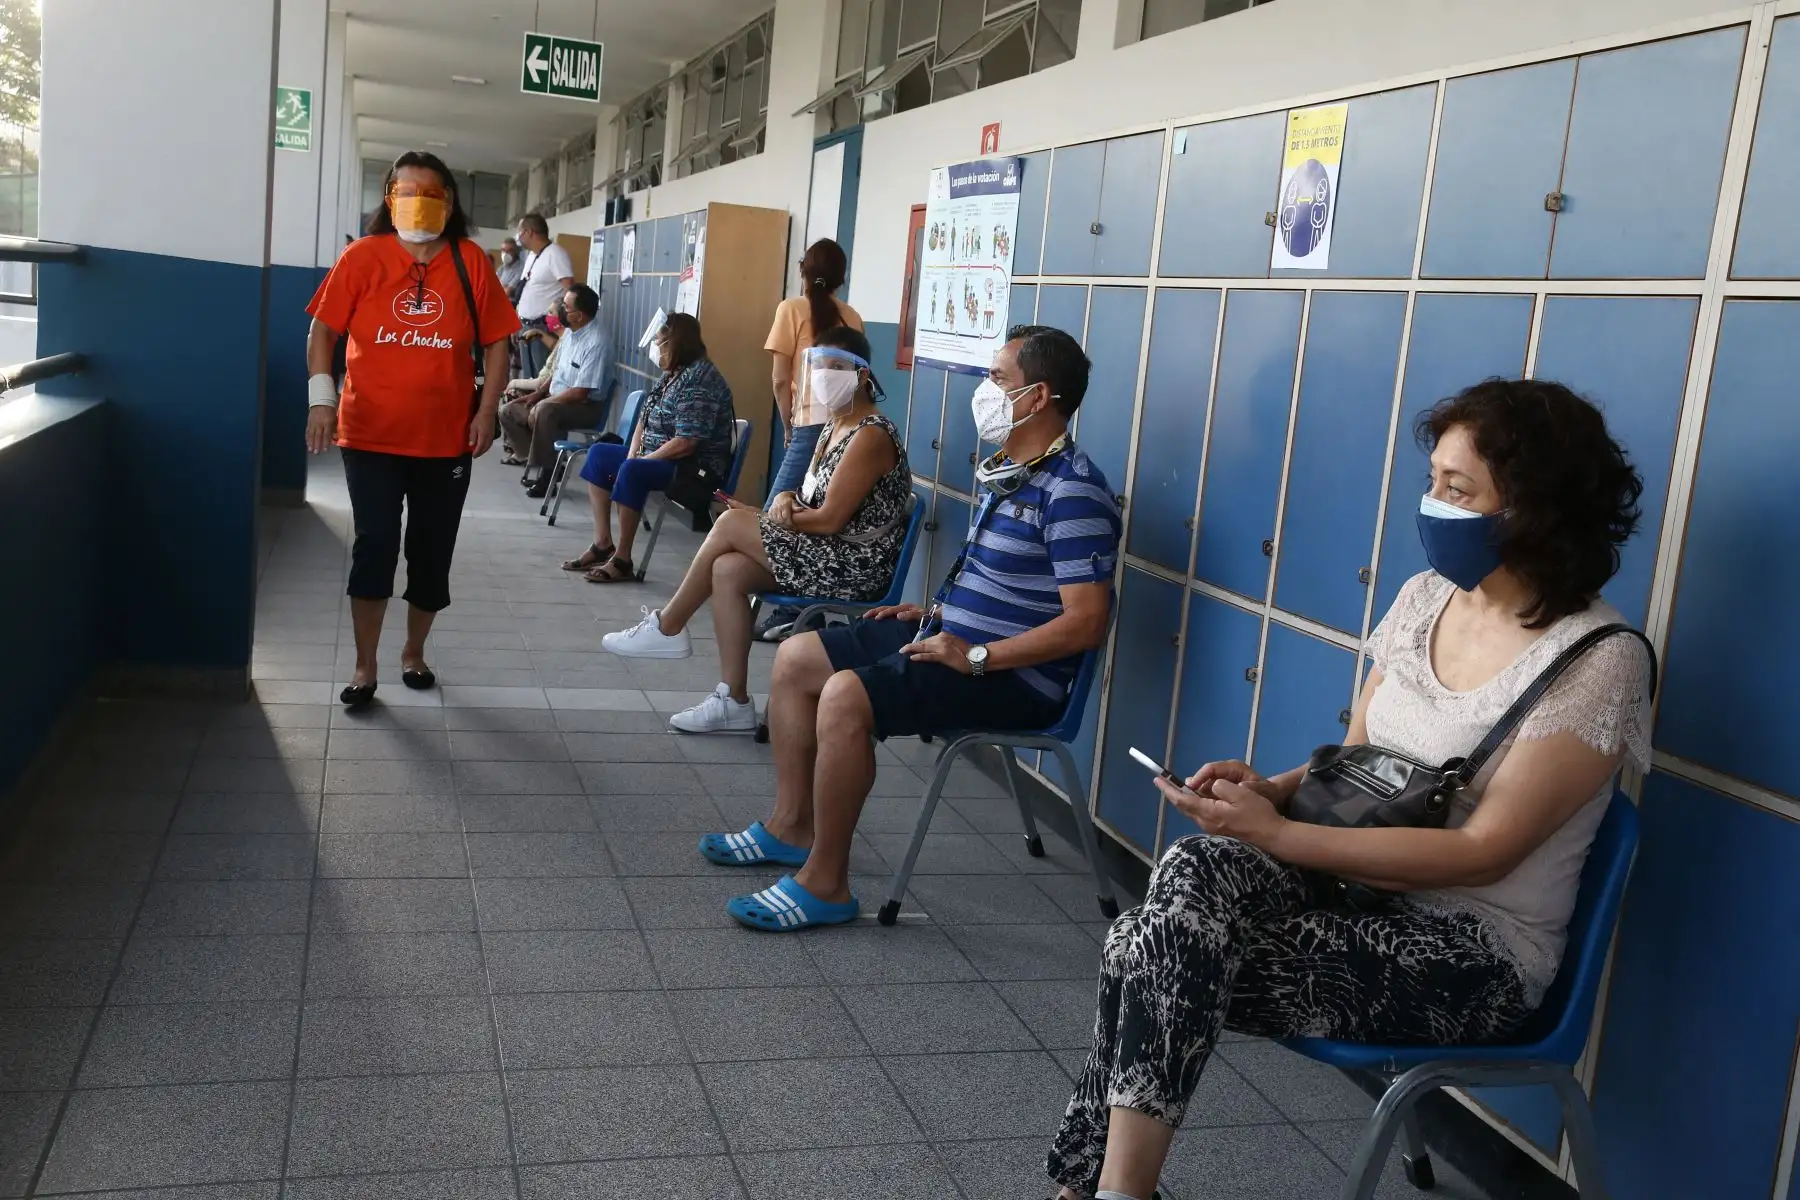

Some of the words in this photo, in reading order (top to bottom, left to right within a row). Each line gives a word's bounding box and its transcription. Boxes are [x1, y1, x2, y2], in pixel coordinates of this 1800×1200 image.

[552, 46, 597, 91] SALIDA
[1291, 141, 1300, 151] DE
[1311, 136, 1338, 148] METROS
[978, 170, 999, 183] votación
[374, 325, 398, 344] Los
[401, 330, 453, 349] Choches
